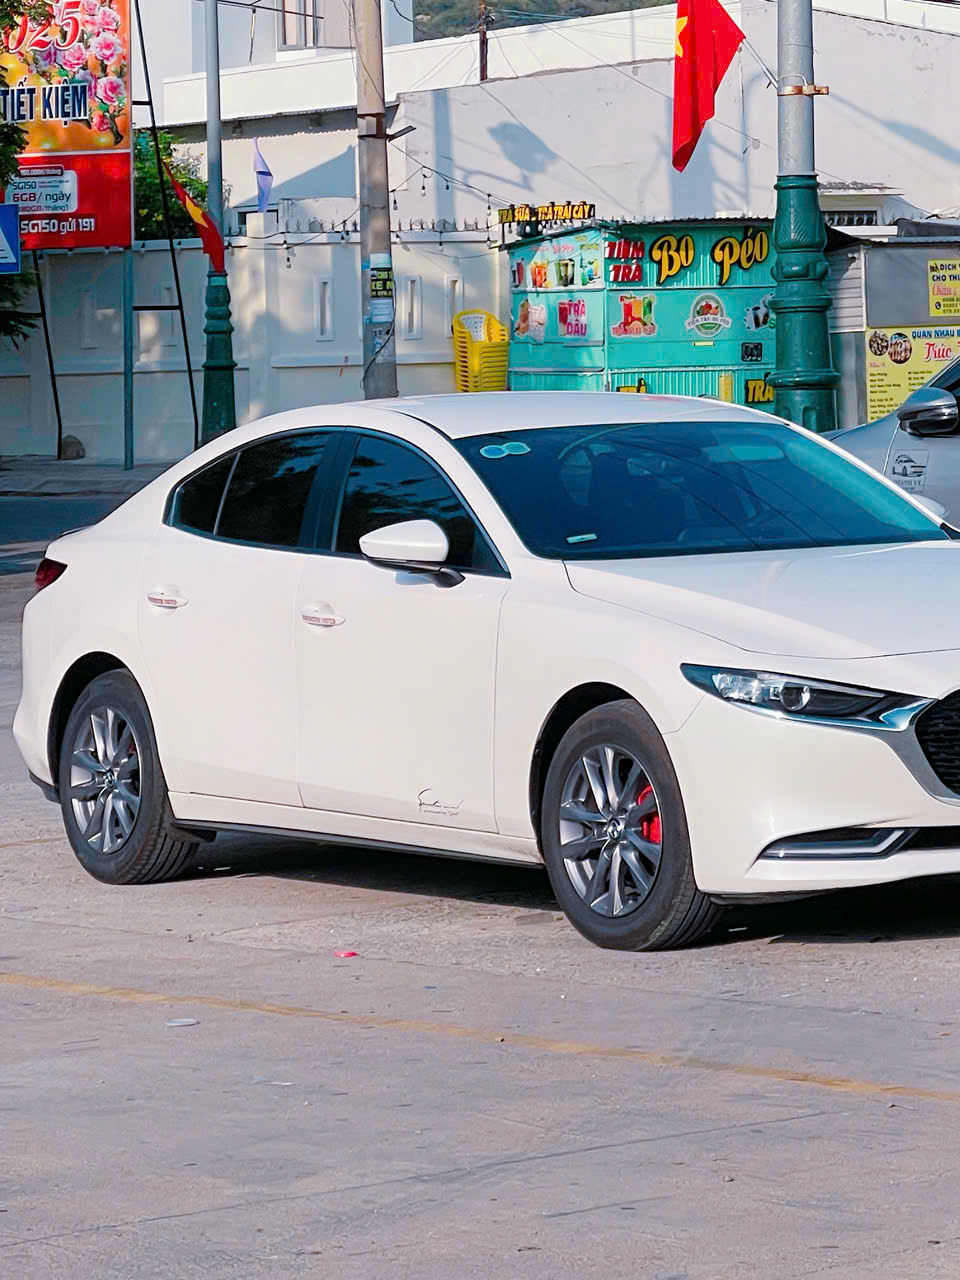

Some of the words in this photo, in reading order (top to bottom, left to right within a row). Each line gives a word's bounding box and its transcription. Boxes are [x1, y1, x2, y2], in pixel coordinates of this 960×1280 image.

[0, 77, 36, 121] TIẾT
[42, 78, 88, 126] KIỆM
[45, 190, 72, 203] ngày
[20, 219, 58, 234] SG150
[78, 218, 95, 231] 191
